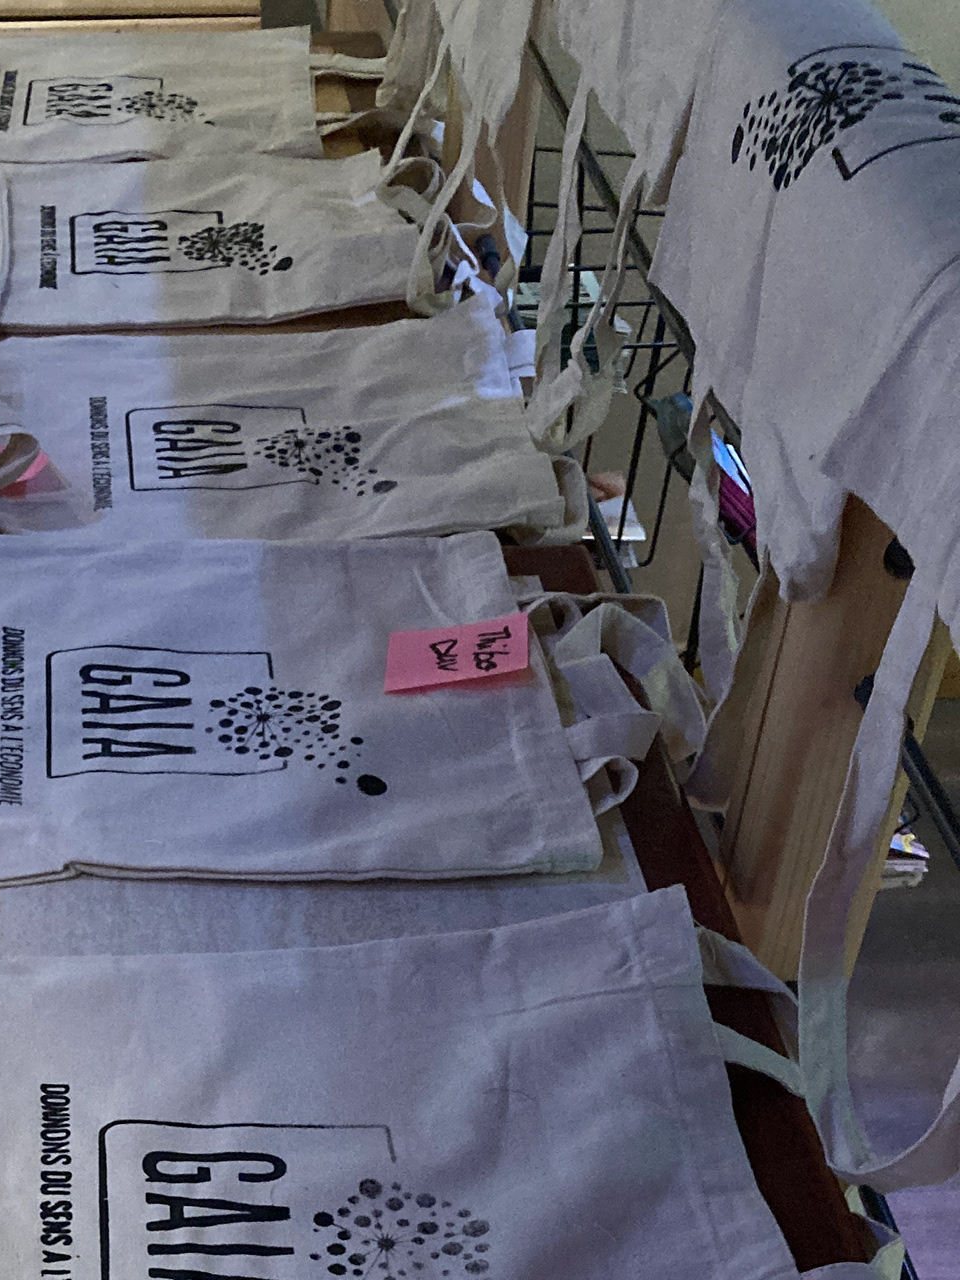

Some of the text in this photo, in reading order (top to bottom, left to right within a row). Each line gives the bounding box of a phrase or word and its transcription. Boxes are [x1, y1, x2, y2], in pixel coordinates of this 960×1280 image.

[93, 220, 171, 266] GAIA
[152, 419, 248, 480] GAIA
[0, 694, 24, 721] SENS
[1, 677, 25, 693] DU
[79, 663, 196, 760] GAIA
[40, 1083, 72, 1165] DONNONS
[40, 1170, 72, 1196] DU
[40, 1200, 73, 1246] SENS
